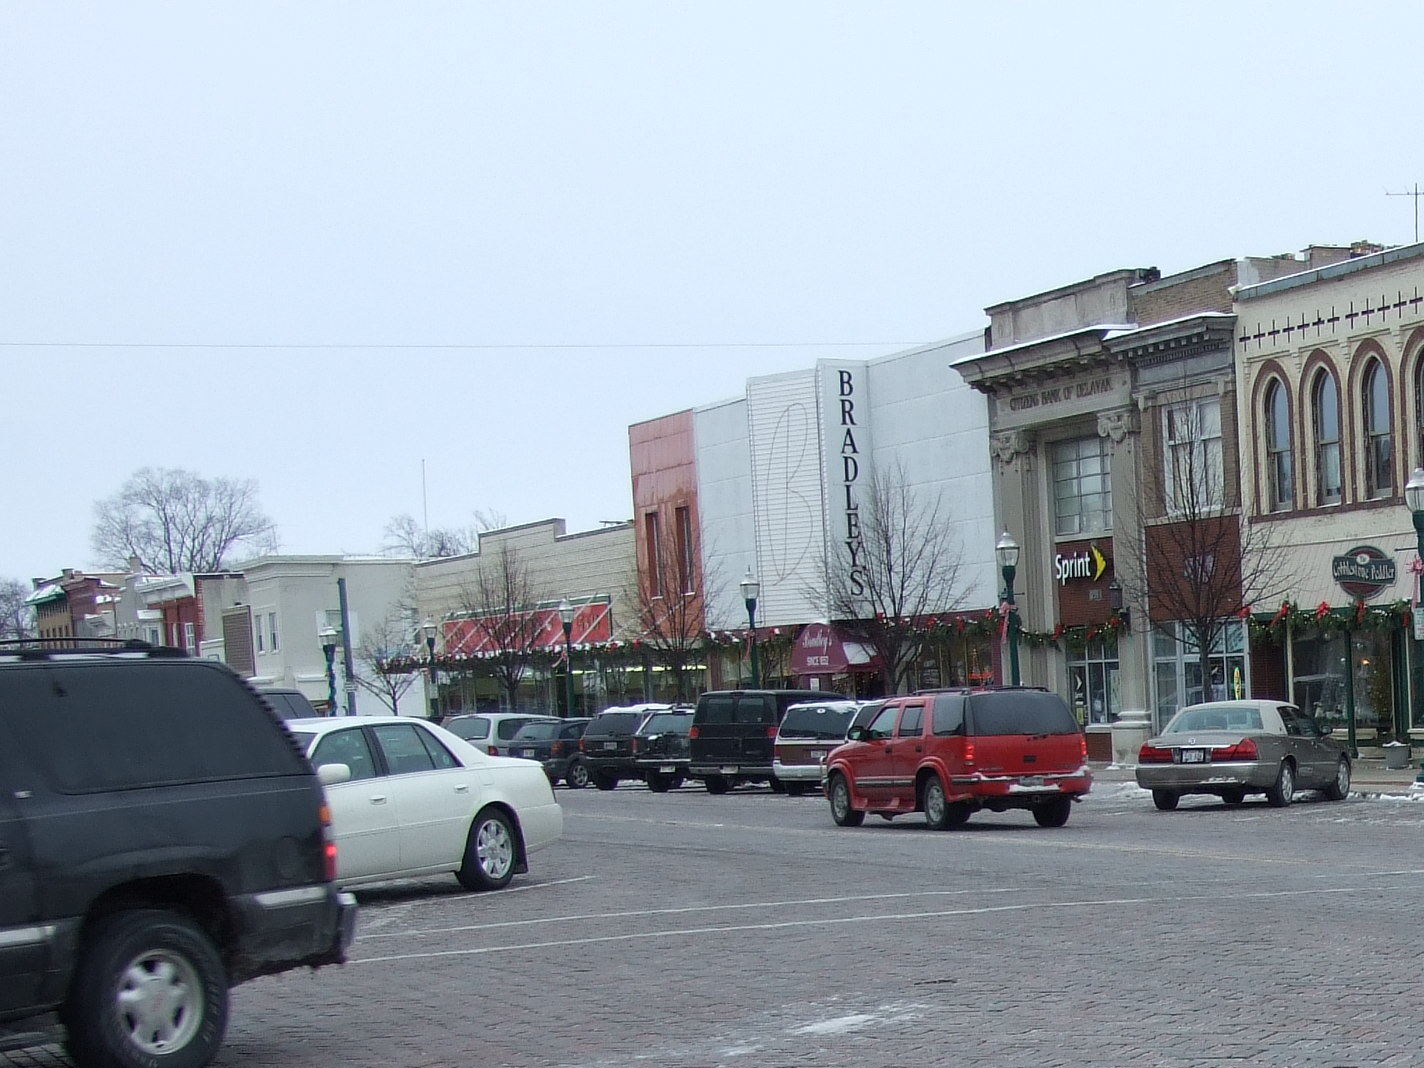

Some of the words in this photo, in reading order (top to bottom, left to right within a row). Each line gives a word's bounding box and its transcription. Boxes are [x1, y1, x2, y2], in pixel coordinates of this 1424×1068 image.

[1041, 388, 1062, 406] BANK
[1062, 386, 1075, 400] OF
[1076, 377, 1114, 399] DELAVAN
[1055, 551, 1091, 586] Sprint
